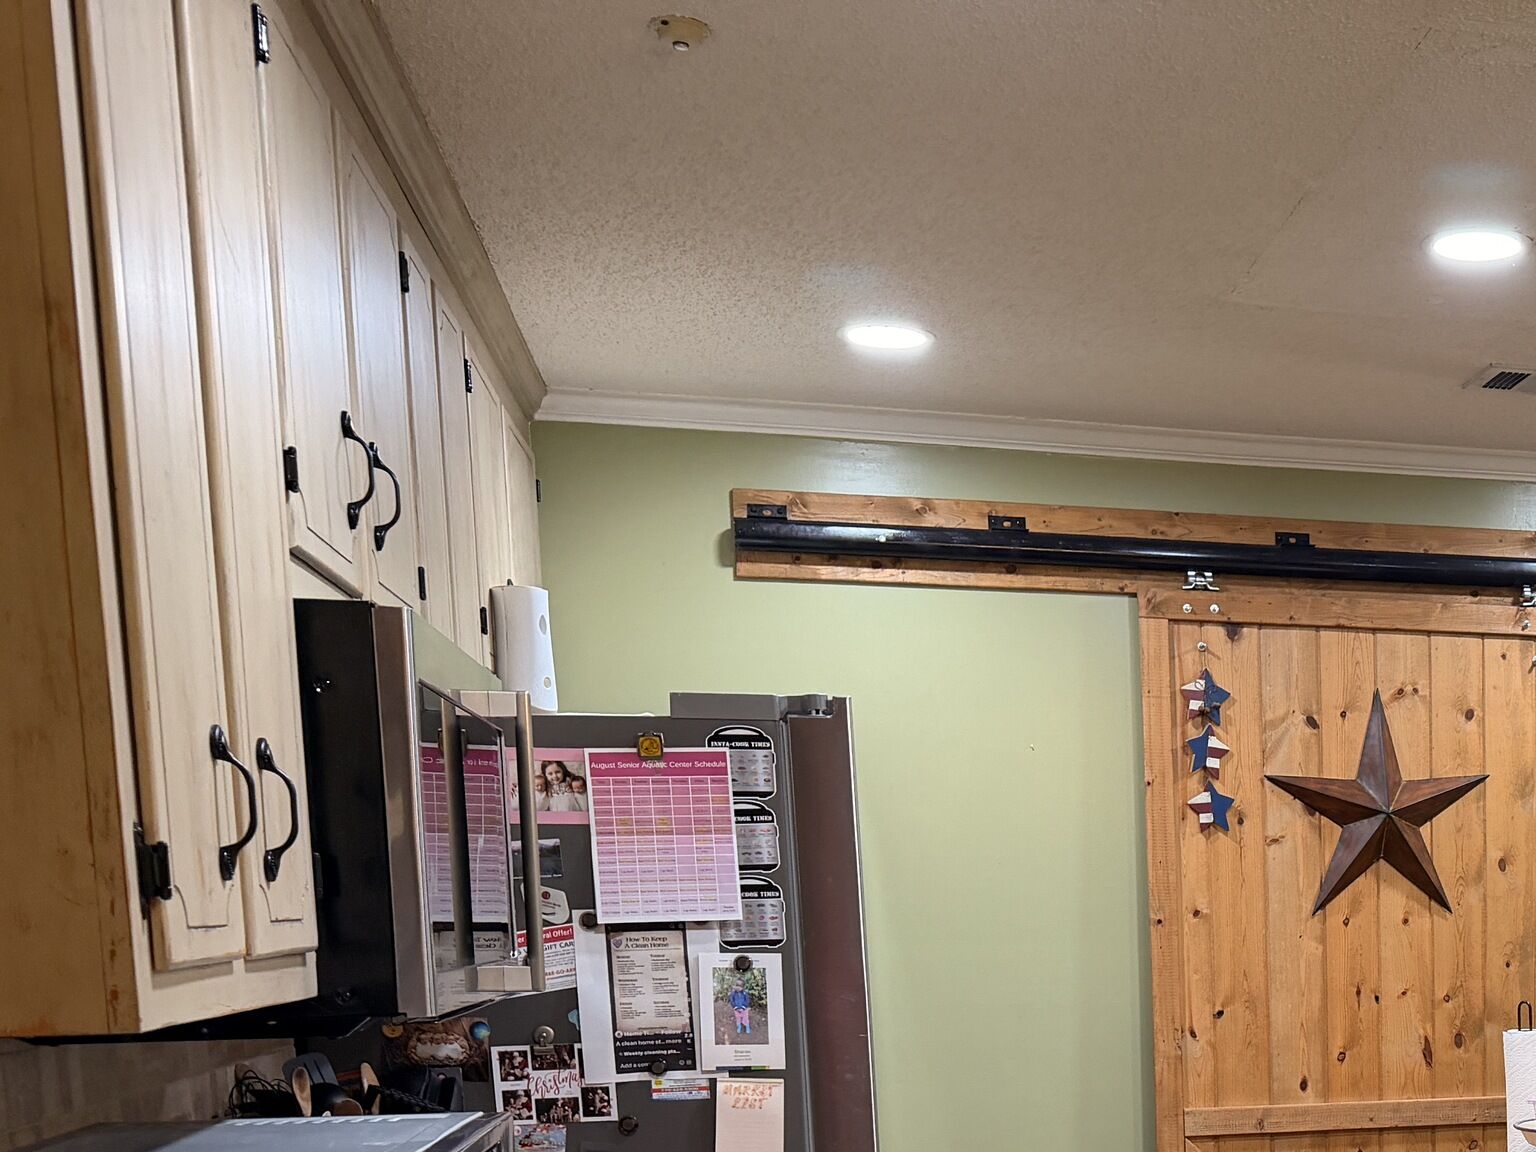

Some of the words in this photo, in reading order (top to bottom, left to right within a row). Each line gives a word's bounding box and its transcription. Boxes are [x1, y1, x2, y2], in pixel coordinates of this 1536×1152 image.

[751, 740, 770, 748] TIMES
[591, 761, 616, 770] August
[617, 761, 640, 769] Senior
[641, 760, 668, 769] Aquatic
[694, 760, 726, 768] Schedule
[552, 928, 573, 937] Offer!
[559, 941, 575, 949] CAR
[527, 1069, 583, 1099] Christmas
[723, 1085, 780, 1097] MARKET
[731, 1098, 768, 1110] LIST
